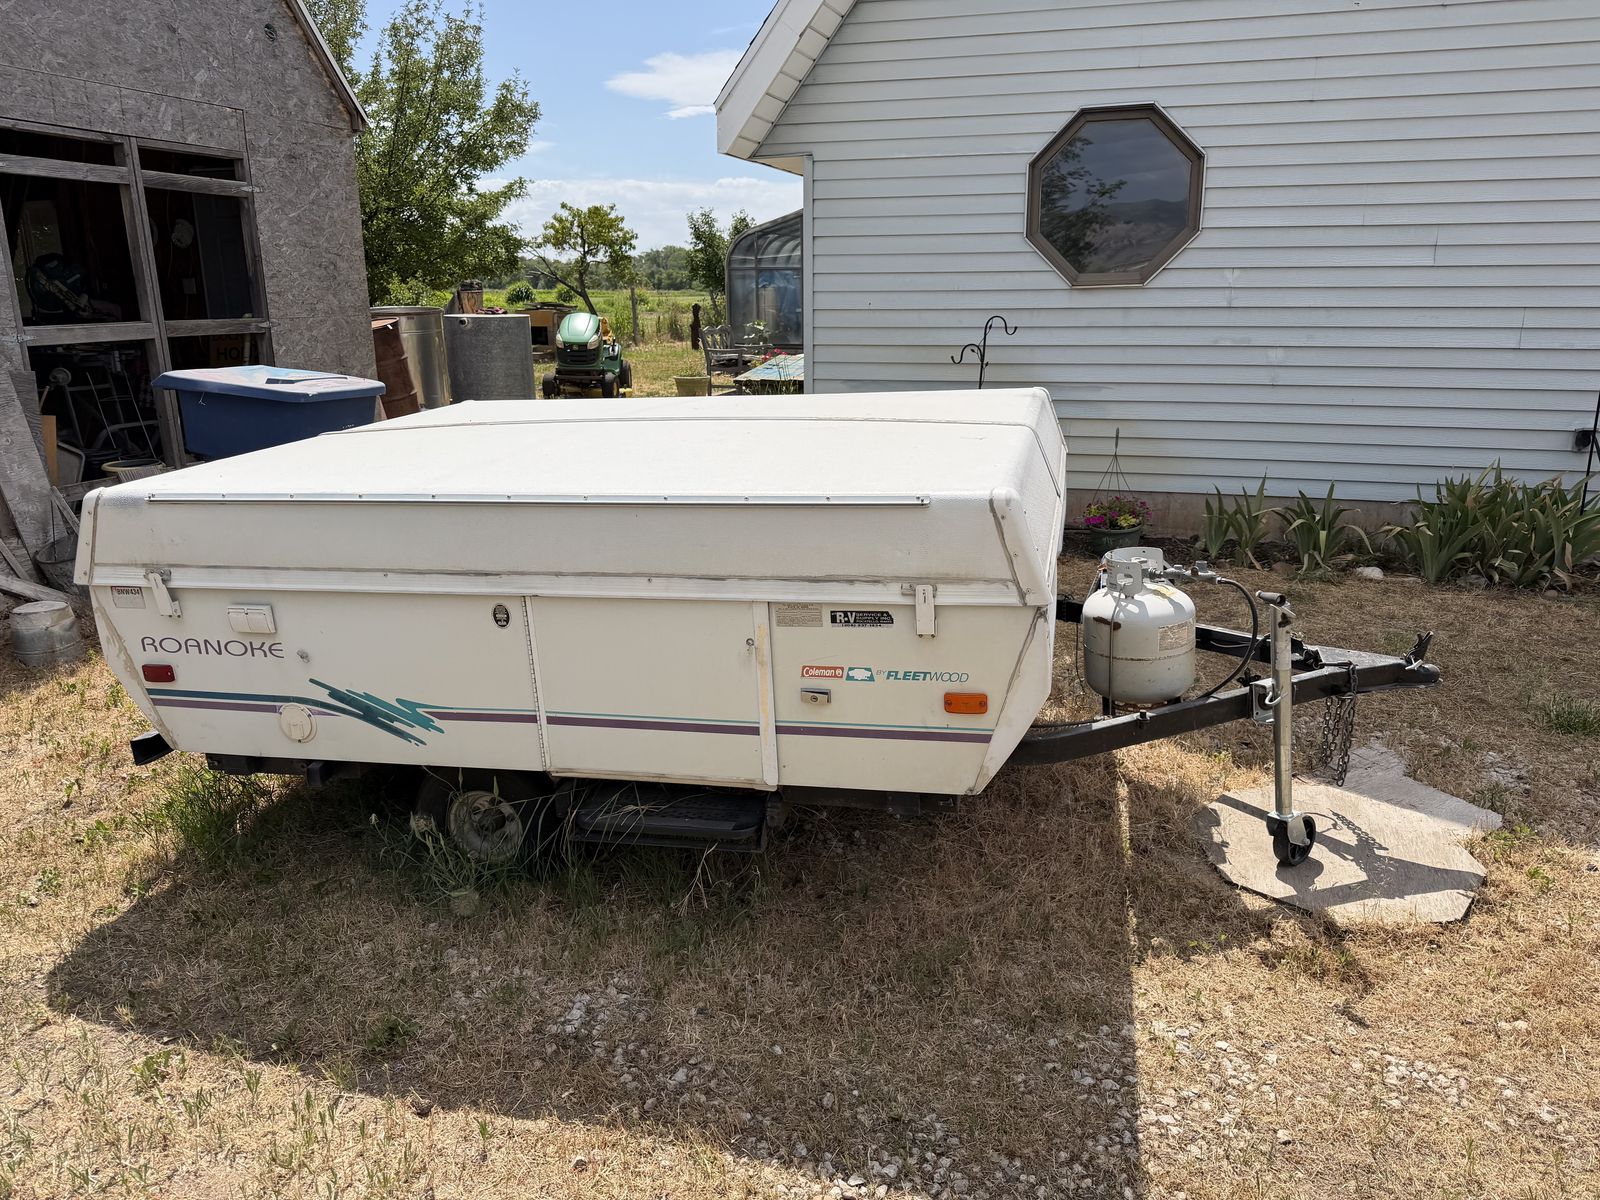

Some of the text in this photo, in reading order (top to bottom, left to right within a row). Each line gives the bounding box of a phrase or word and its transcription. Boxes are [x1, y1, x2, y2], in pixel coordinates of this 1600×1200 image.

[140, 636, 285, 659] ROANOKE
[803, 666, 835, 677] Coleman
[886, 670, 969, 683] FLEETWOOD
